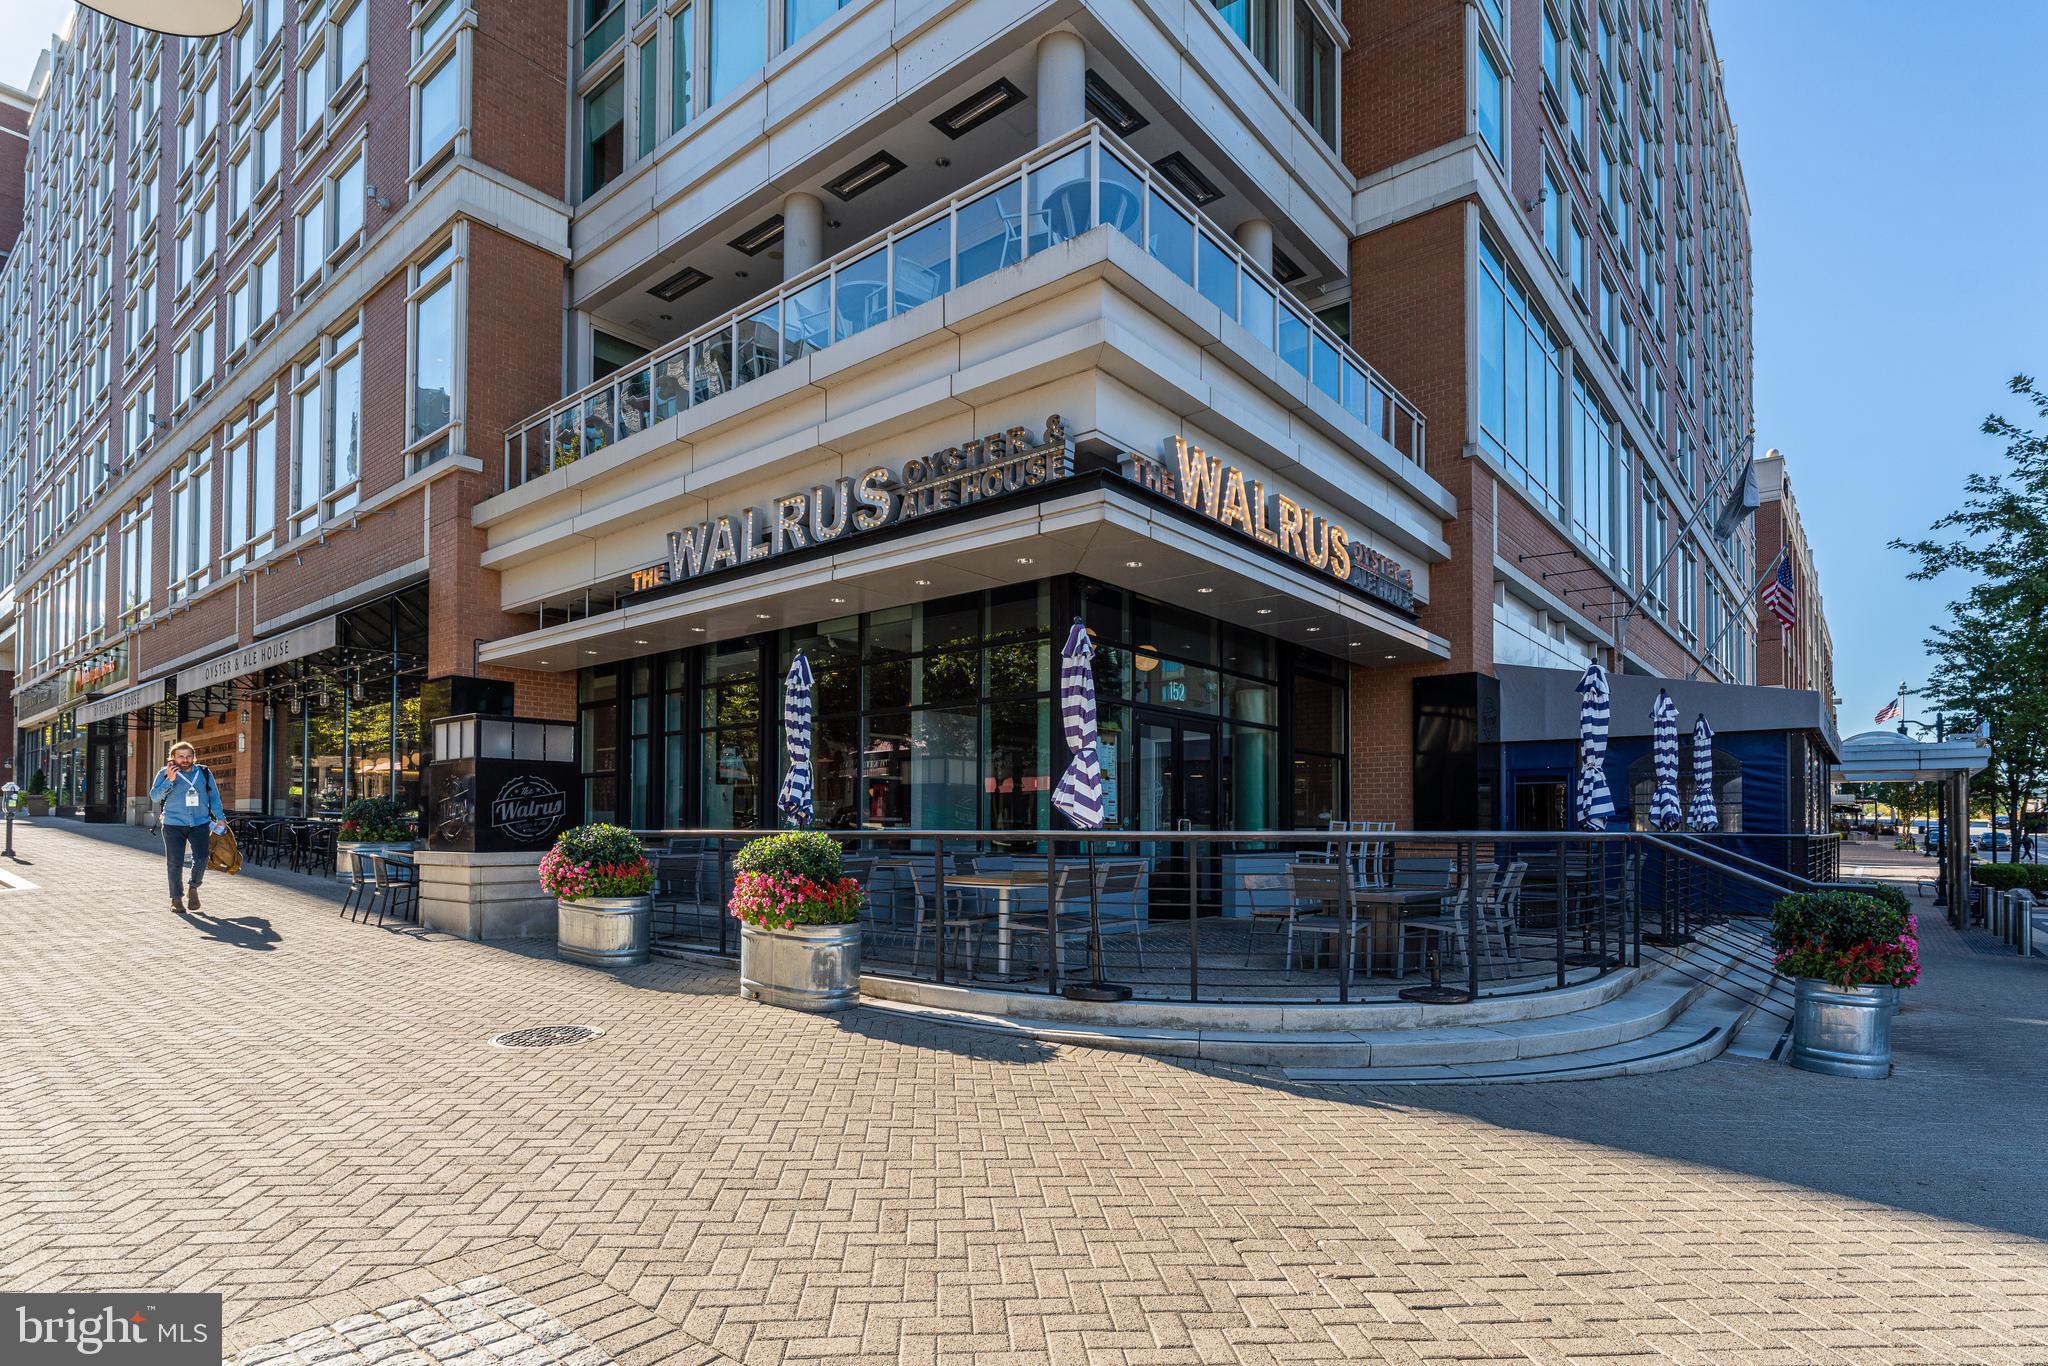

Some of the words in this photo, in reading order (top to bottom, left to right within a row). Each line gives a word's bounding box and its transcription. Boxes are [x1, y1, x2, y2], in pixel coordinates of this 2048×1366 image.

[902, 425, 1034, 486] OYSTER
[1043, 414, 1069, 443] &
[899, 482, 960, 521] ALE
[961, 446, 1075, 503] HOUSE
[1118, 452, 1176, 500] THE
[1163, 435, 1351, 580] WALRUS
[631, 563, 669, 594] THE
[667, 466, 900, 581] WALRUS
[1350, 541, 1401, 582] OYSTER
[205, 660, 231, 680] OYSTER
[234, 658, 240, 671] &
[243, 652, 257, 668] ALE
[261, 640, 289, 662] HOUSE
[1168, 680, 1185, 702] 152
[495, 799, 562, 821] Walrus
